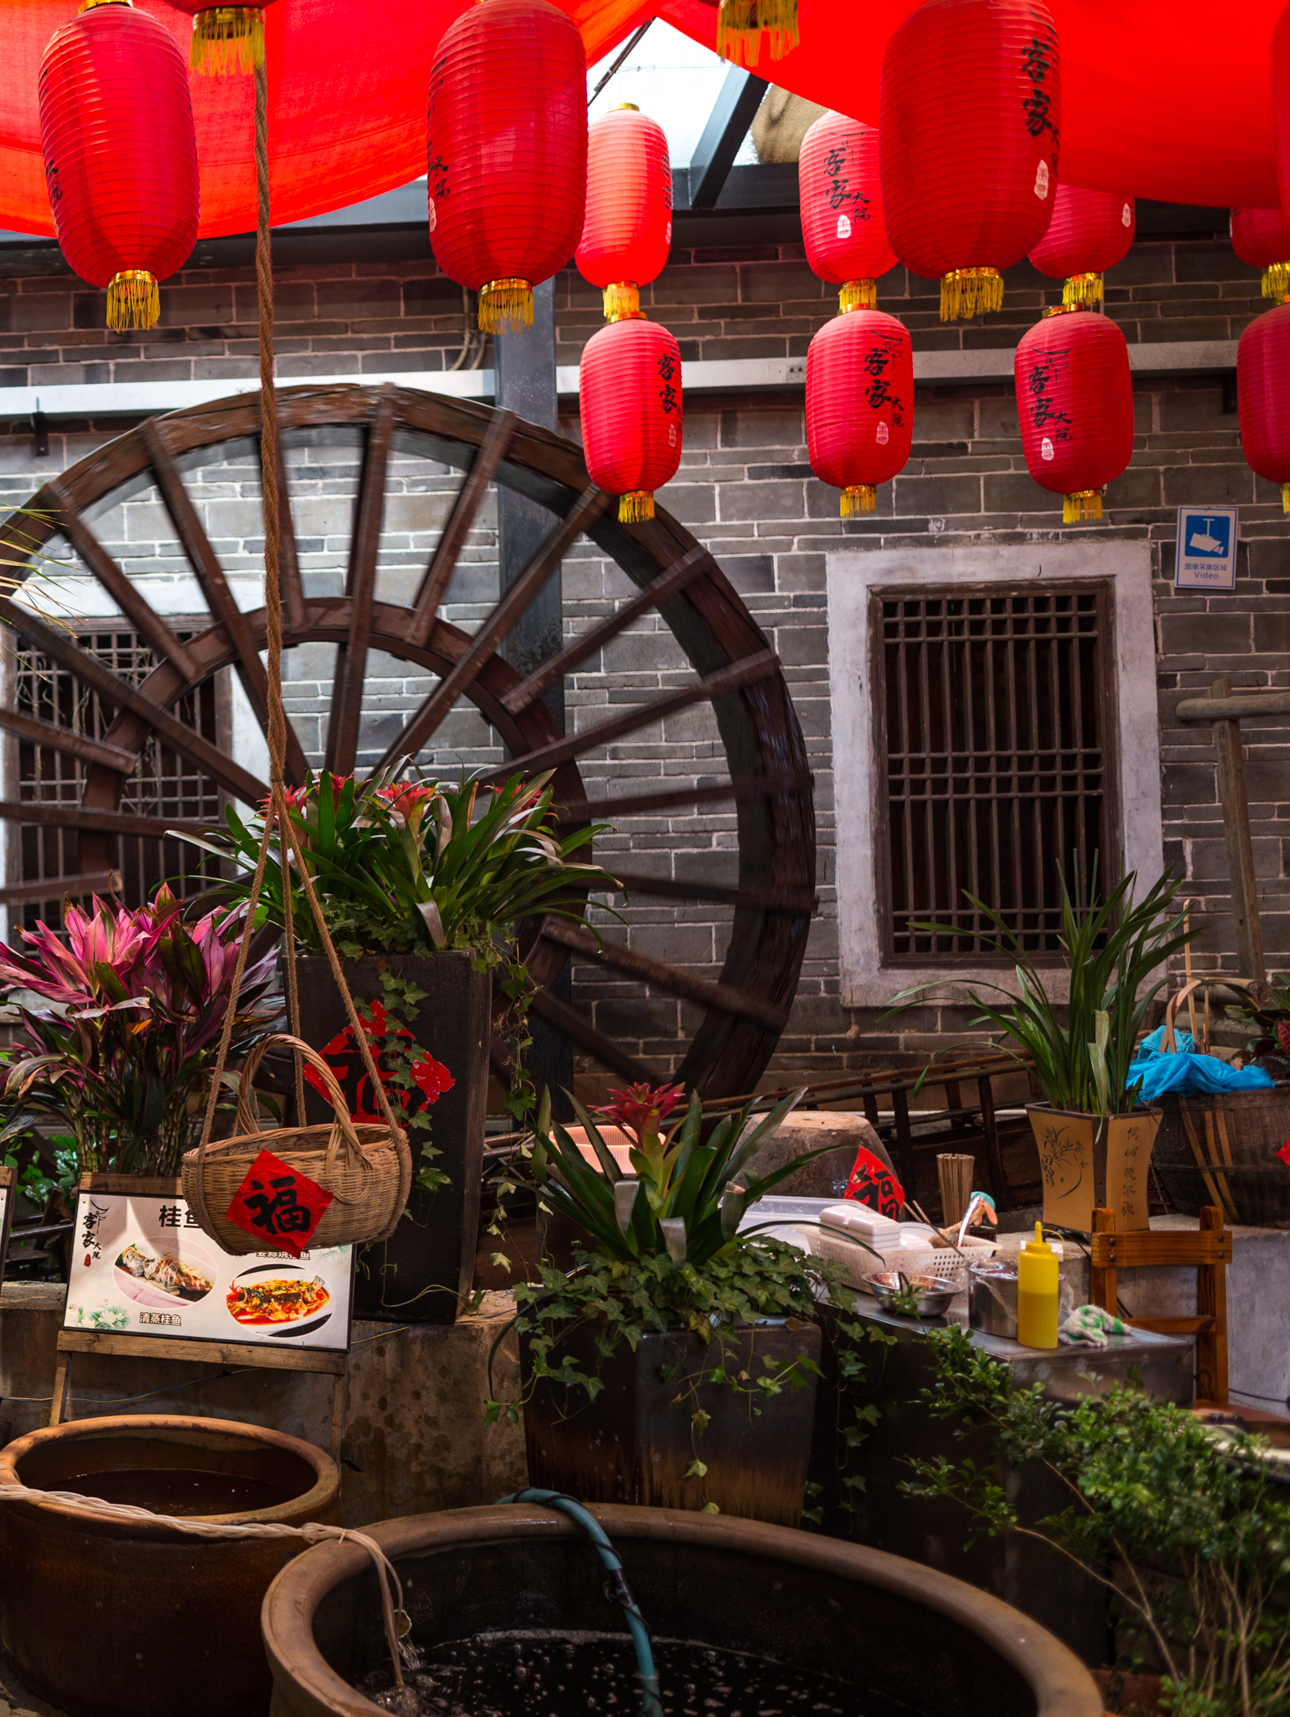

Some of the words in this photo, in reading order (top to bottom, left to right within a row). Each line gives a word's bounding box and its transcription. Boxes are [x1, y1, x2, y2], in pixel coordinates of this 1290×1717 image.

[1184, 562, 1228, 572] 图像采集区域
[1194, 571, 1219, 580] Video
[852, 1164, 901, 1220] 福
[244, 1174, 311, 1236] 福
[139, 1311, 182, 1327] 清蒸桂鱼
